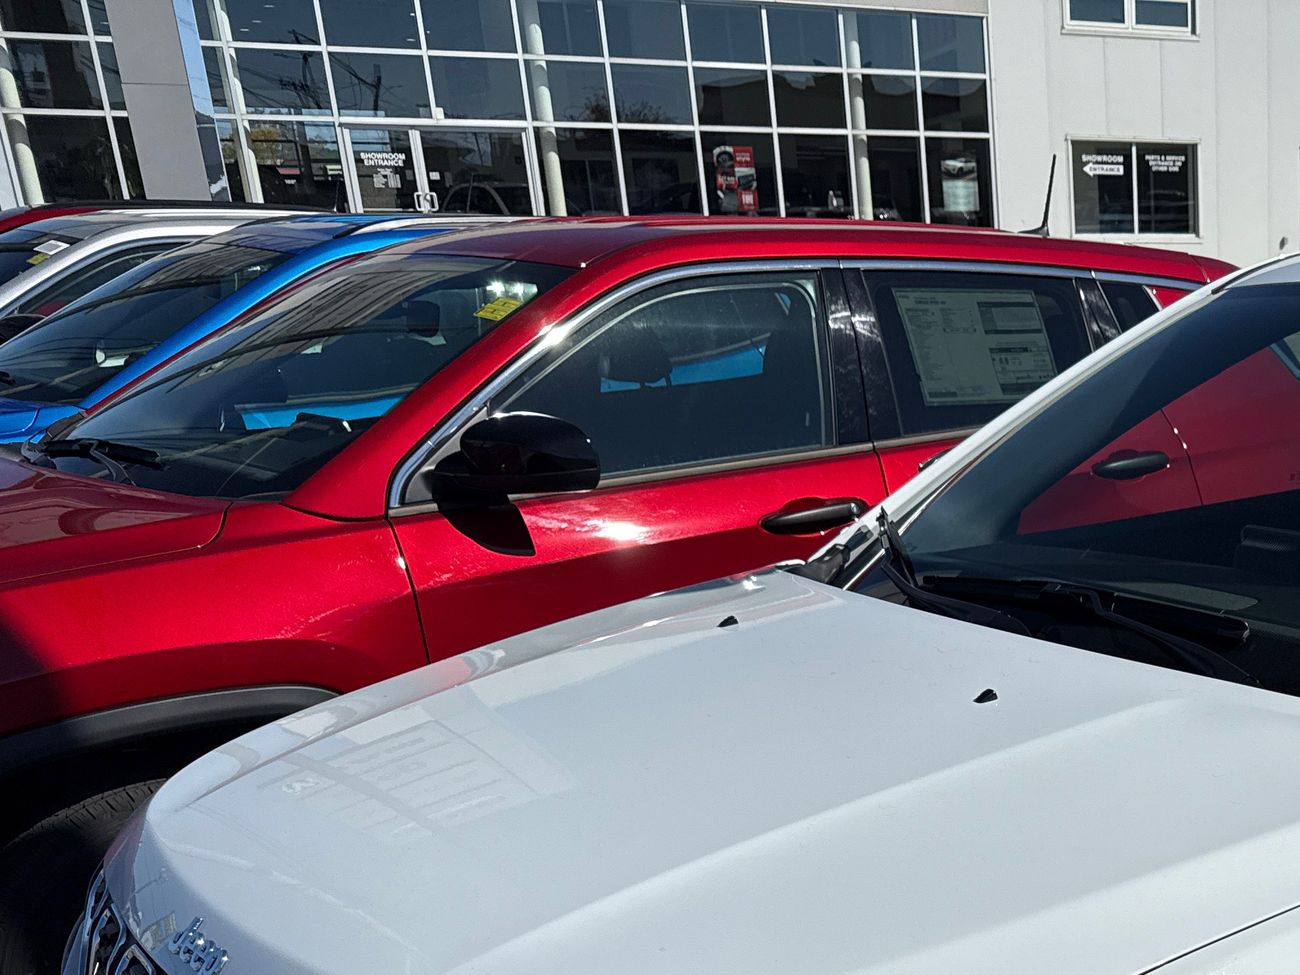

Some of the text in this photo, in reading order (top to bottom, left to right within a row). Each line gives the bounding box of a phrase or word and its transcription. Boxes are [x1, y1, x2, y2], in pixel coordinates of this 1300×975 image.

[360, 152, 406, 160] SHOWROOM
[1081, 154, 1124, 163] SHOWROOM
[364, 159, 404, 167] ENTRANCE
